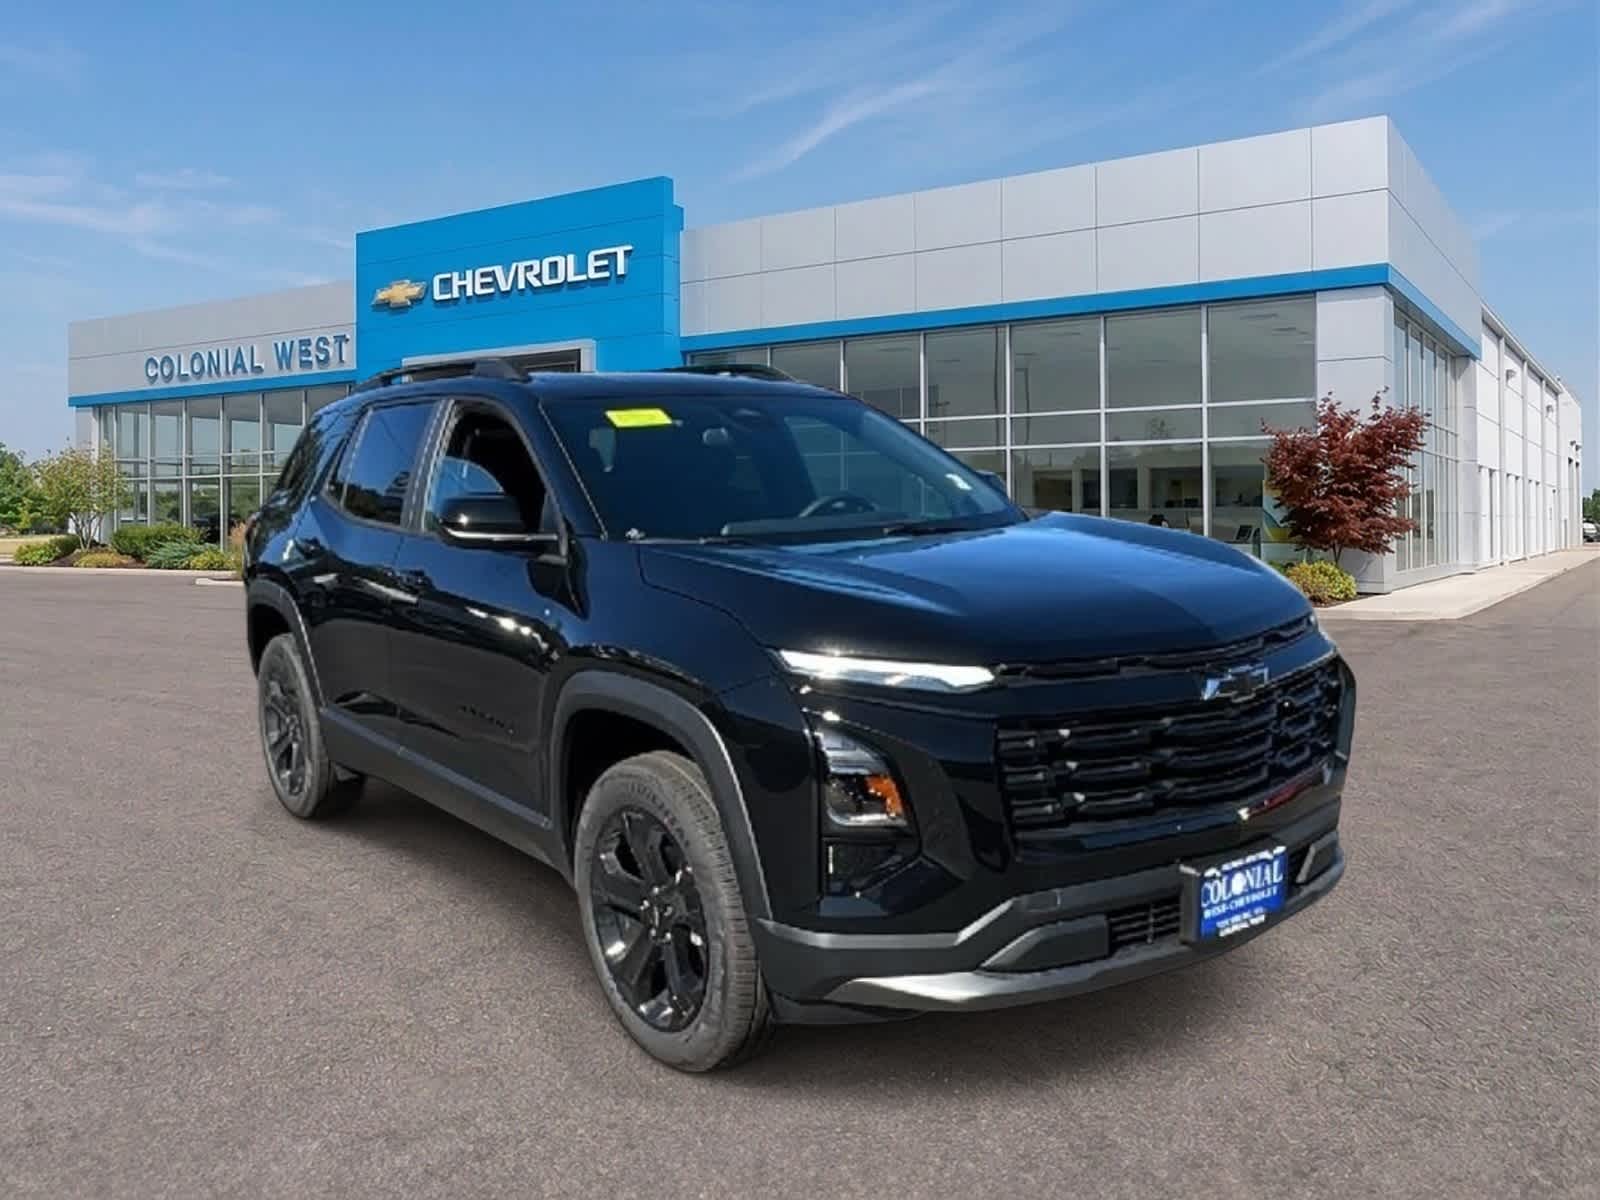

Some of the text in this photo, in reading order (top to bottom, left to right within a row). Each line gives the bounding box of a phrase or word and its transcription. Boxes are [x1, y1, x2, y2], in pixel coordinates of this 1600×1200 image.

[433, 245, 633, 300] CHEVROLET
[145, 334, 350, 383] COLONIAL WEST
[1201, 859, 1284, 908] COLONIAL
